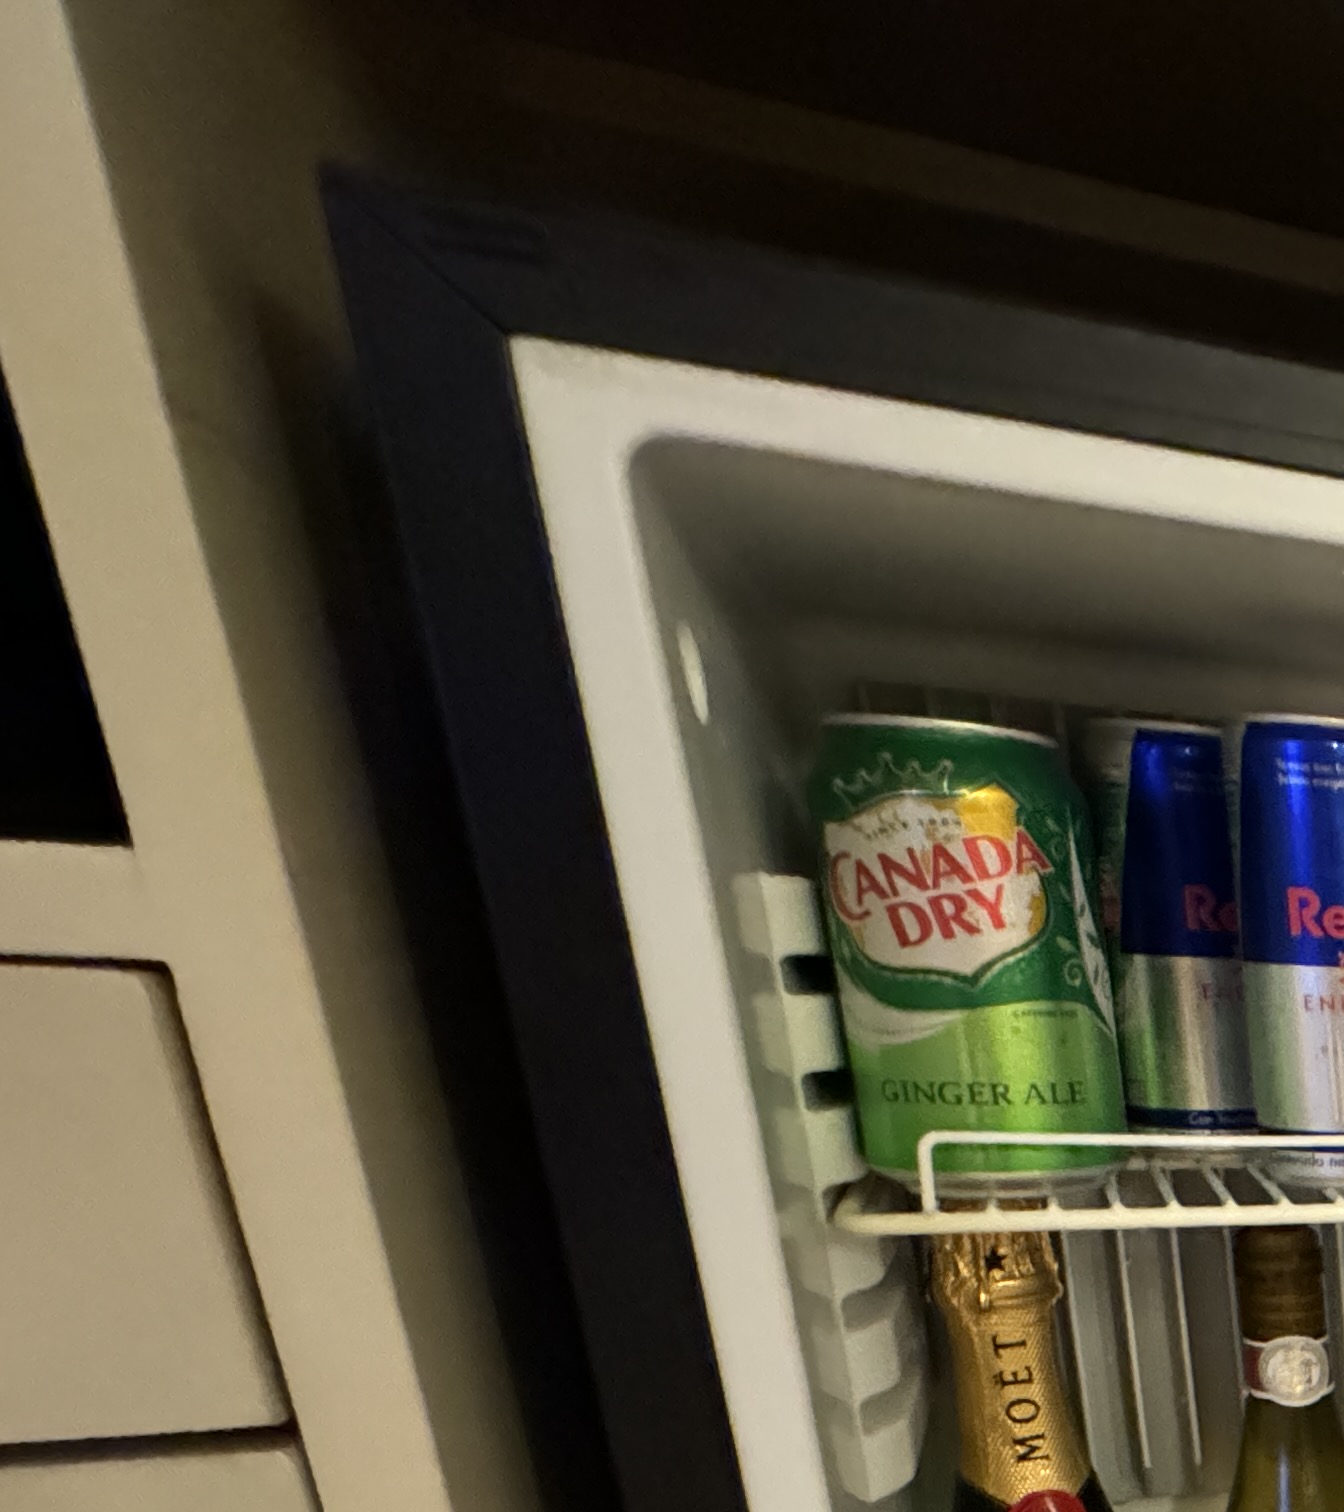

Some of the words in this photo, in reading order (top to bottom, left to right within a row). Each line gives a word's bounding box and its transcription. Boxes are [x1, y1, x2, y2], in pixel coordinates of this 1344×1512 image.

[829, 826, 1052, 921] CANADA
[886, 883, 1006, 948] DRY
[1183, 884, 1241, 932] Re
[881, 1078, 1015, 1105] GINGER
[1024, 1080, 1087, 1105] ALE
[991, 1333, 1051, 1464] MOËT
